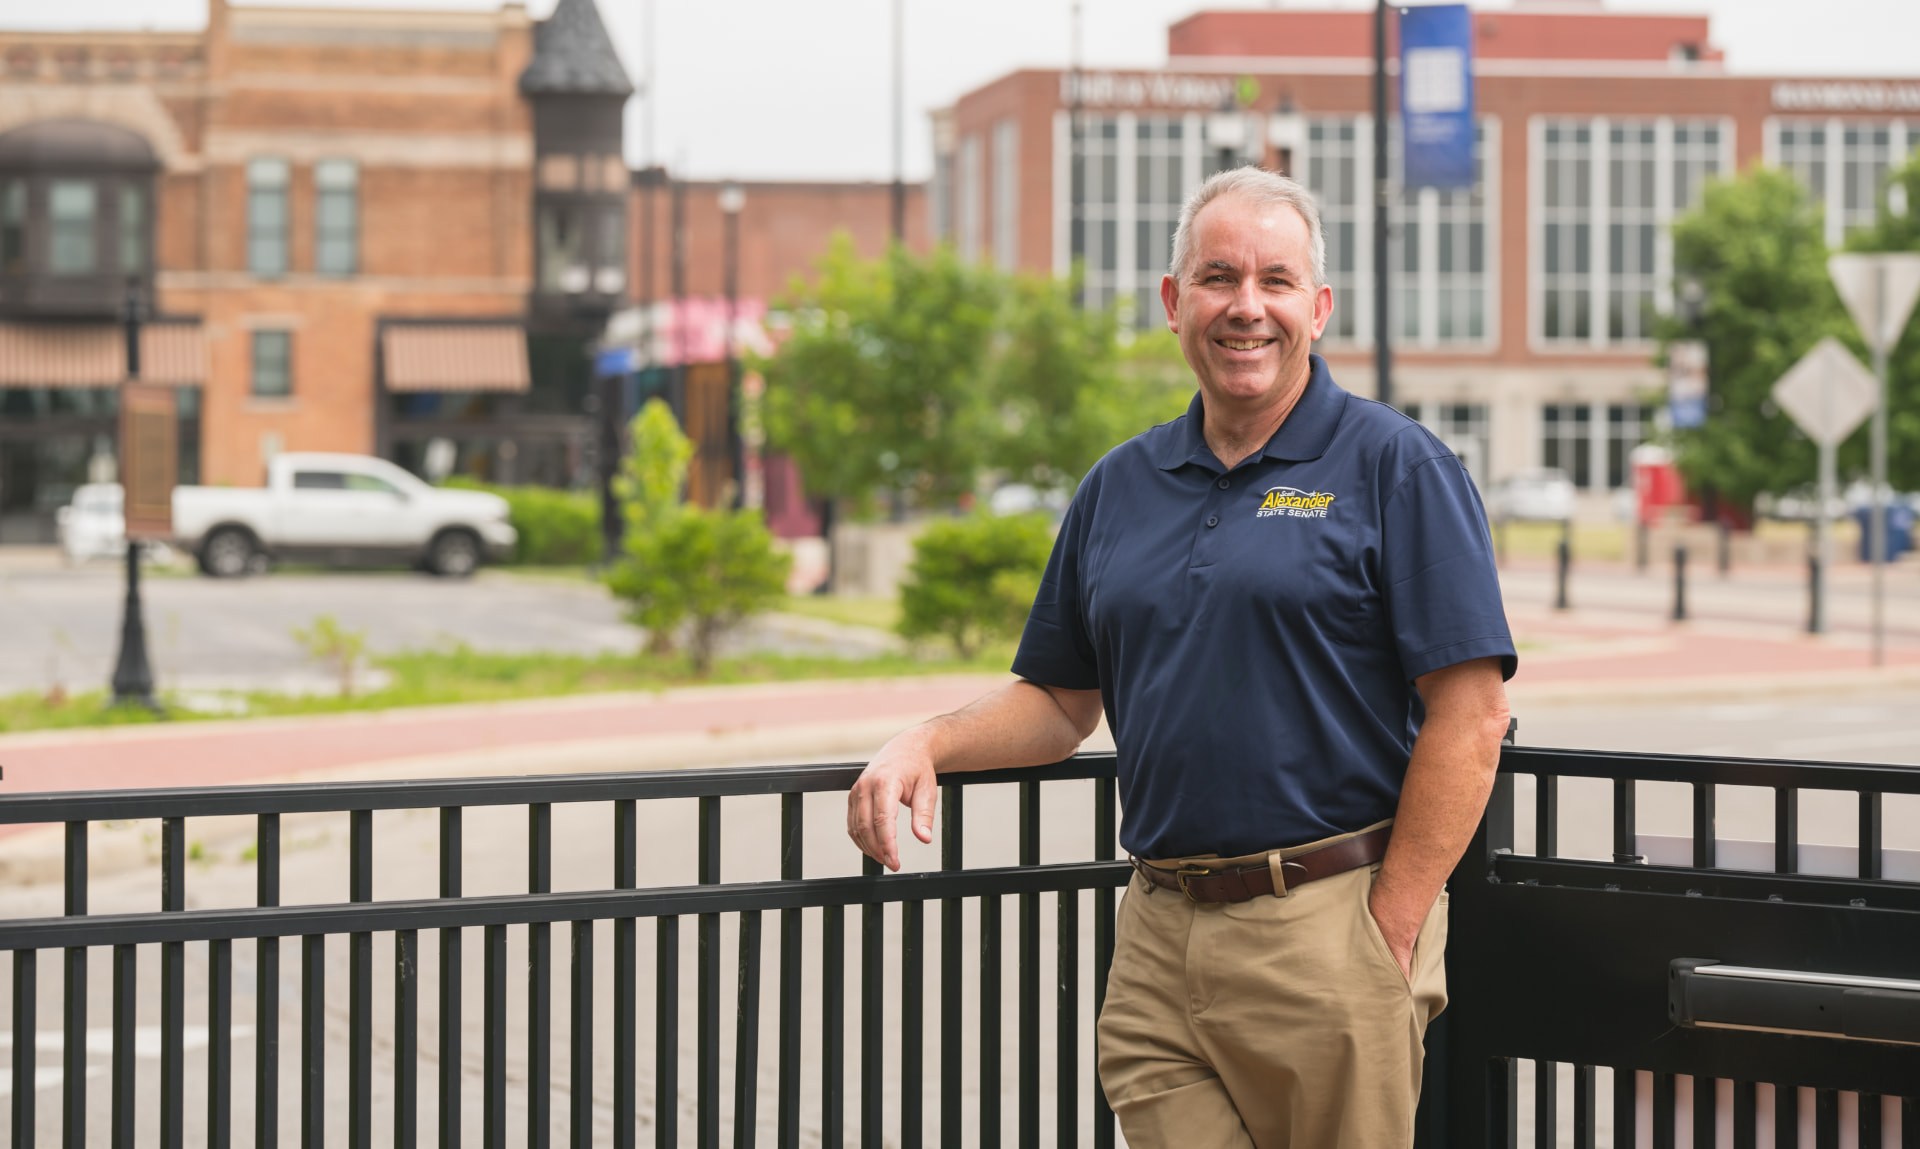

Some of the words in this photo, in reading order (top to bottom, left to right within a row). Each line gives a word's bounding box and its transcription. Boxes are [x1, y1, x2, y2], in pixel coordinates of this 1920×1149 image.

[1261, 492, 1334, 508] Alexander
[1256, 509, 1286, 518] STATE
[1287, 509, 1328, 518] SENATE
